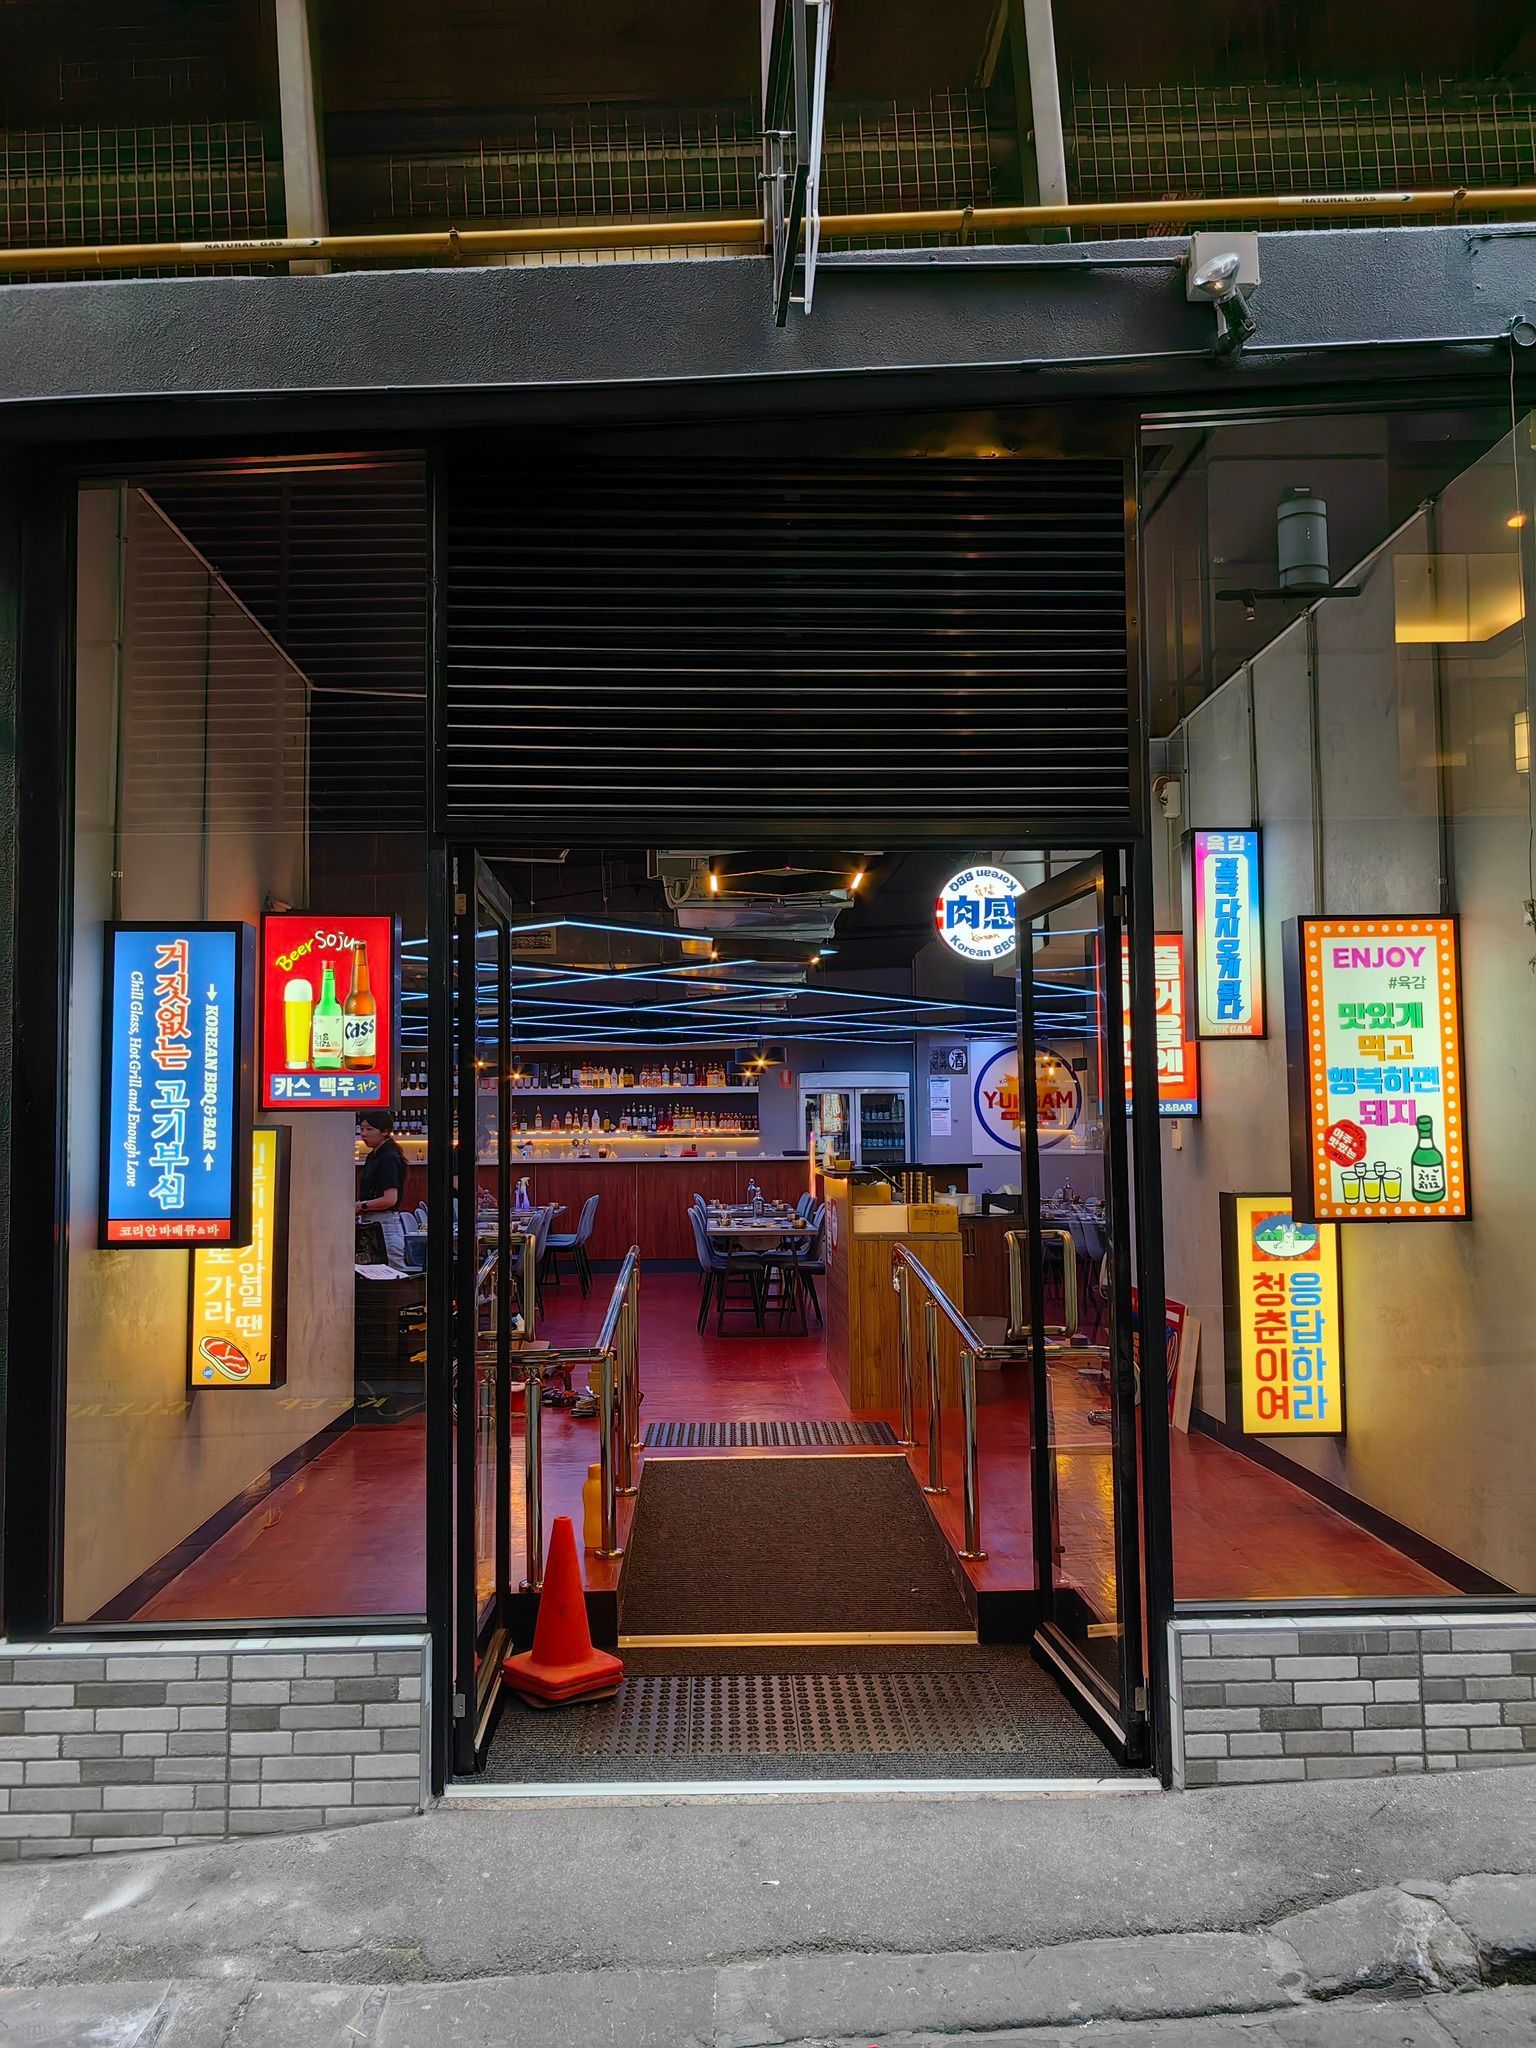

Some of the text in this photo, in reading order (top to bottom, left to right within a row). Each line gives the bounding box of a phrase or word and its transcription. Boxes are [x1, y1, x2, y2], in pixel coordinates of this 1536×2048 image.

[1301, 196, 1350, 204] NATURAL
[204, 241, 256, 249] NATURAL
[948, 868, 1018, 892] Korean BBQ
[946, 895, 1017, 930] 肉感
[1214, 898, 1243, 938] 다시
[275, 930, 355, 972] Beer Soju
[949, 935, 992, 957] Korean
[1215, 939, 1242, 978] 오게
[1332, 946, 1426, 970] ENJOY
[1388, 975, 1427, 991] #육감
[1216, 979, 1245, 1020] 된다
[345, 1018, 375, 1040] Cass
[1229, 1024, 1253, 1034] GAM
[1337, 1001, 1425, 1030] 맛있게
[205, 1004, 219, 1070] KOREAN
[1357, 1034, 1415, 1062] 먹고
[951, 1051, 964, 1068] 酒
[123, 971, 145, 1188] Chill Glass, Hot Grill and Enough Love
[149, 939, 192, 1210] 거짓없는 고기부심
[274, 1077, 312, 1097] 카스
[319, 1077, 356, 1097] 맥주
[1326, 1065, 1441, 1097] 행복하면
[983, 1090, 1073, 1109] YUAM
[1358, 1098, 1417, 1127] 돼지
[119, 1224, 158, 1238] 코리안
[203, 1275, 236, 1325] 가라
[235, 1314, 263, 1338] 땐
[1252, 1271, 1290, 1421] 청춘이여
[1288, 1271, 1329, 1420] 응답하라
